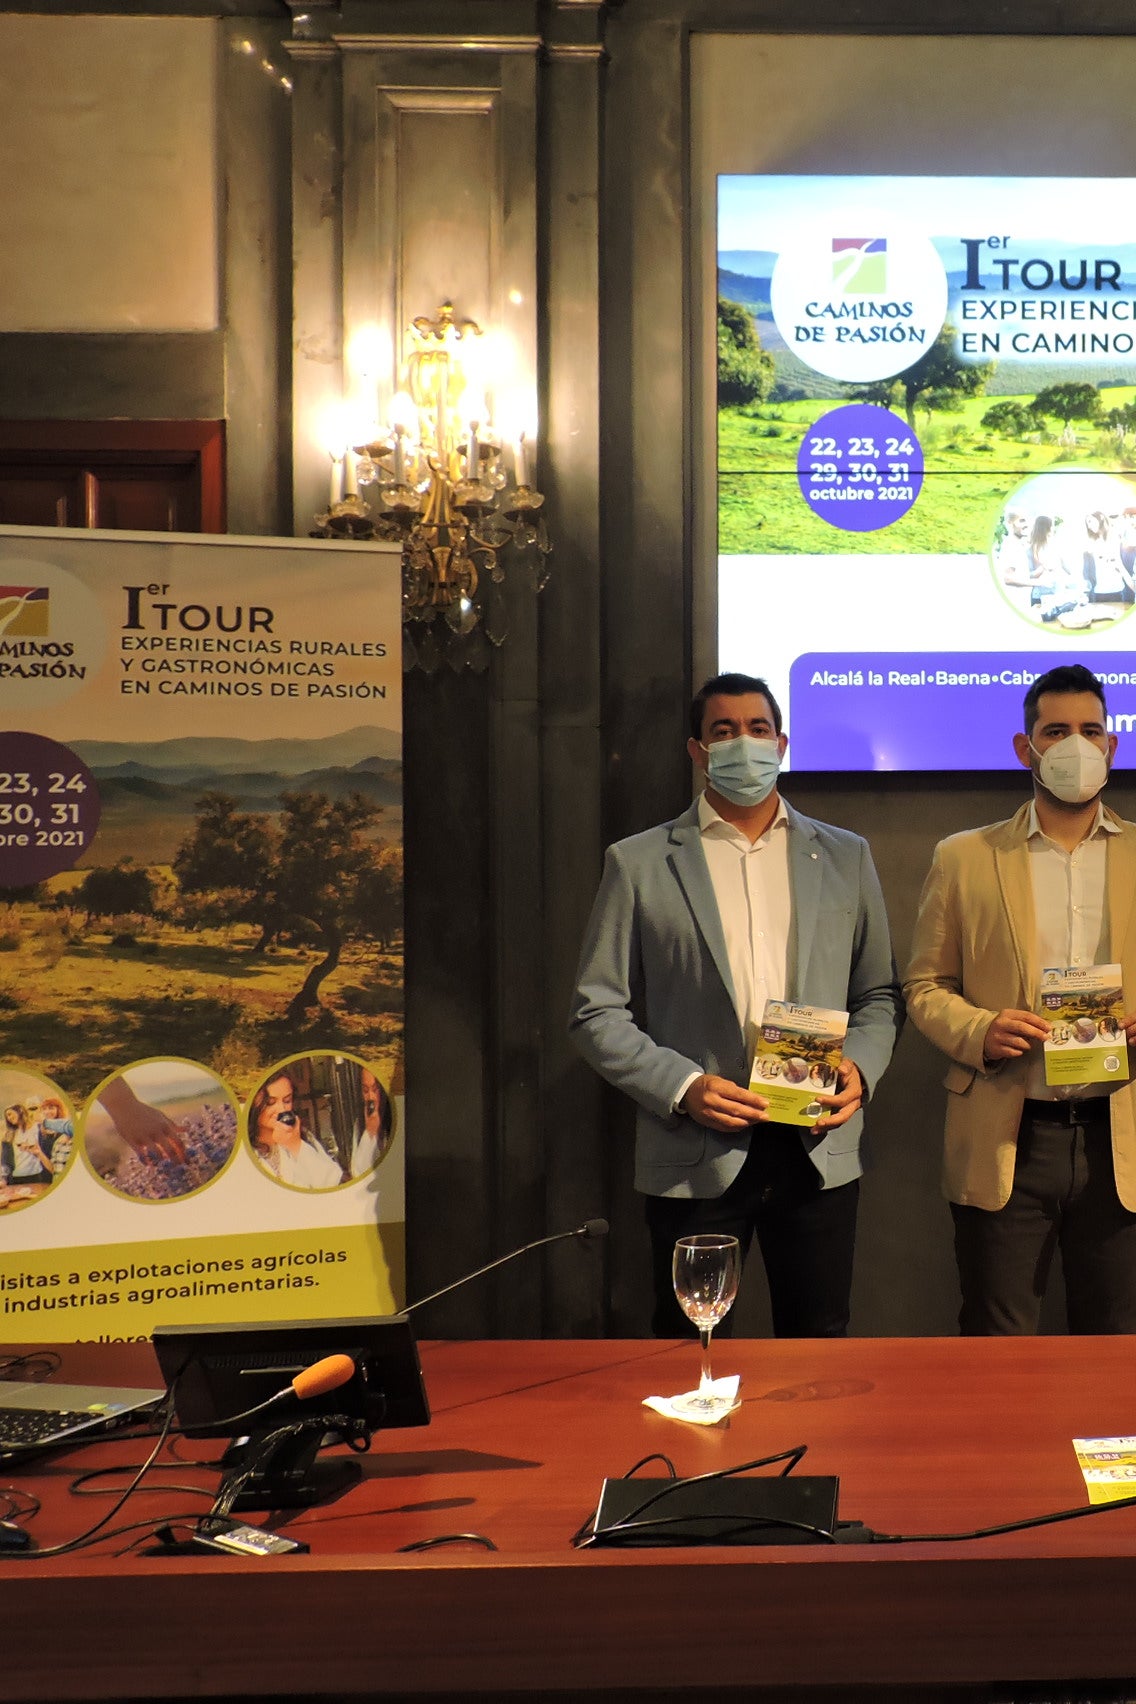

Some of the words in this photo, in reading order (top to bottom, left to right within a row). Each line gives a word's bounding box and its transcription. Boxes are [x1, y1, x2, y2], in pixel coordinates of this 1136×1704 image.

[992, 259, 1121, 291] TOUR
[805, 301, 913, 320] CAMINOS
[795, 325, 826, 342] DE
[836, 322, 926, 344] PASIÓN
[962, 333, 1000, 353] EN
[810, 437, 843, 459] 22,
[848, 437, 880, 459] 23,
[885, 438, 914, 456] 24
[810, 463, 843, 485] 29,
[848, 463, 883, 485] 30,
[888, 463, 909, 482] 31
[809, 486, 874, 501] octubre
[878, 486, 913, 500] 2021
[152, 603, 274, 634] TOUR
[0, 641, 74, 658] MINOS
[121, 636, 282, 655] EXPERIENCIAS
[290, 641, 387, 657] RURALES
[120, 658, 134, 673] Y
[142, 658, 335, 677] GASTRONÓMICAS
[810, 671, 863, 686] Alcalá
[868, 671, 883, 685] la
[121, 680, 150, 695] EN
[158, 681, 263, 697] CAMINOS
[271, 682, 299, 698] DE
[307, 682, 387, 700] PASIÓN
[48, 773, 87, 793] 24
[51, 804, 79, 824] 31
[36, 831, 84, 846] 2021
[0, 1273, 61, 1291] isitas
[68, 1272, 80, 1284] a
[88, 1259, 244, 1283] explotaciones
[251, 1249, 347, 1271] agrícolas
[5, 1290, 120, 1313] industrias
[127, 1273, 320, 1304] agroalimentarias.
